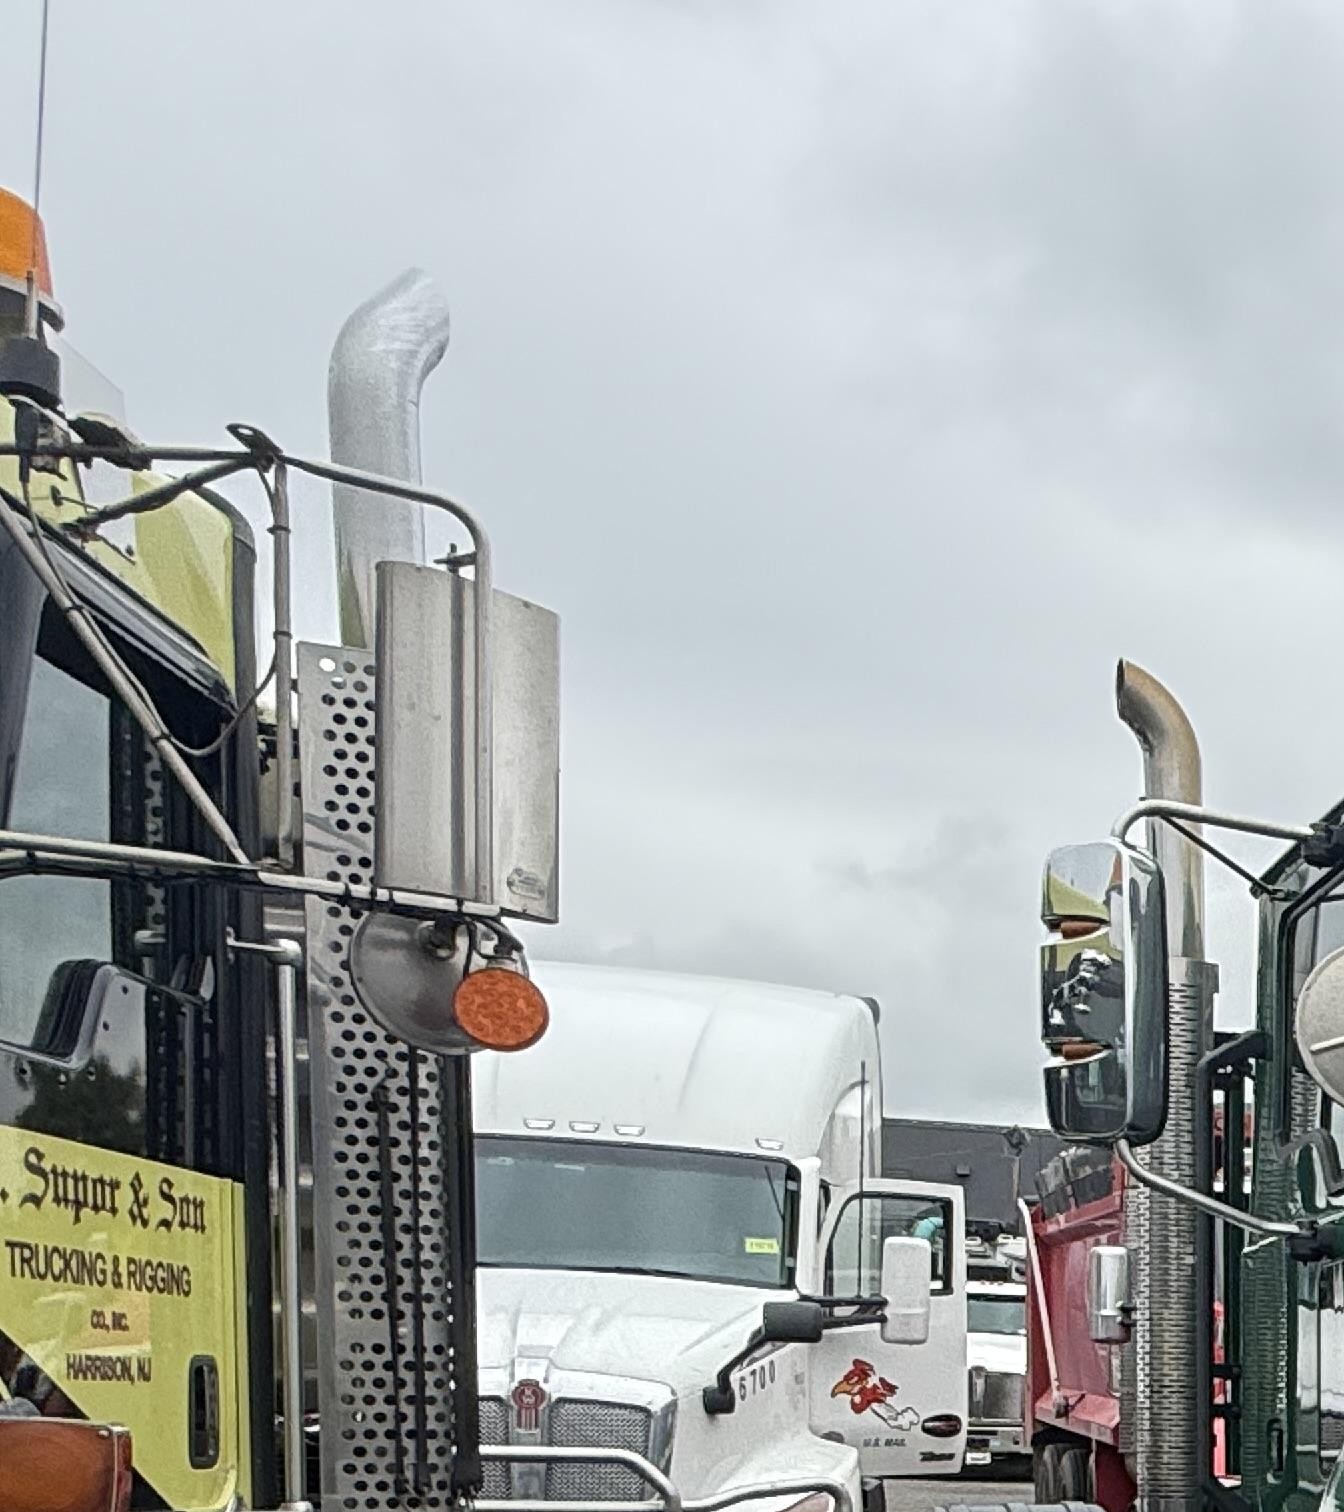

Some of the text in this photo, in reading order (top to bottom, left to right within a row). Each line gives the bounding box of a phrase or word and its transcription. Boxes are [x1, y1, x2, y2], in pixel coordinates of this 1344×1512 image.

[19, 1147, 207, 1234] Supor & Son
[5, 1239, 192, 1298] TRUCKING & RIGGING
[66, 1353, 151, 1385] HARRISON, NJ
